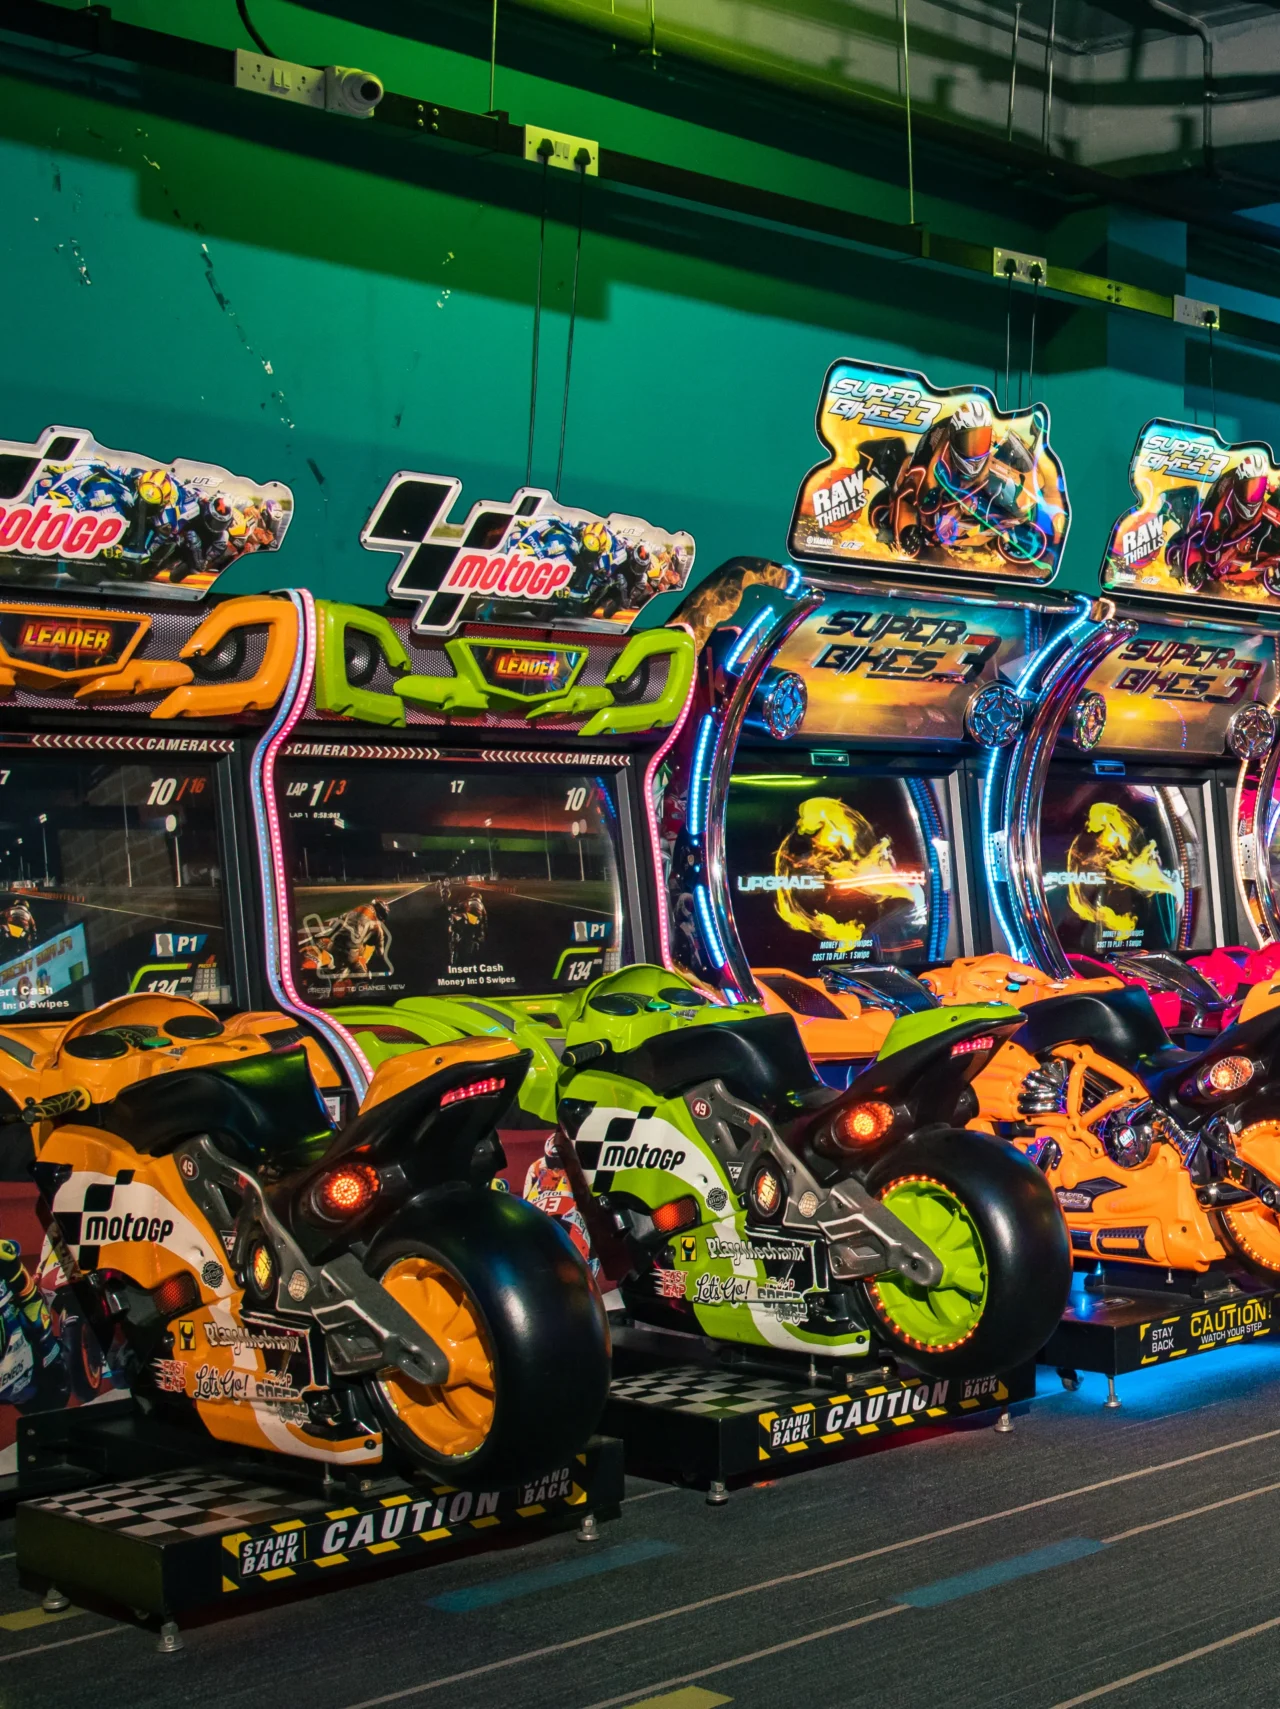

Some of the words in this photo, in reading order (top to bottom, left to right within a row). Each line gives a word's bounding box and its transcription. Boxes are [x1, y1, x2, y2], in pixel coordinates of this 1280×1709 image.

[830, 377, 922, 408] SUPER
[829, 398, 910, 425] BIKES
[1144, 435, 1215, 460] SUPER
[1140, 452, 1203, 473] BIKES
[812, 469, 865, 515] RAW
[816, 493, 868, 529] THRILLS
[0, 505, 123, 553] otoGP
[1122, 514, 1164, 554] RAW
[1124, 534, 1166, 566] THRILLS
[23, 624, 111, 650] LEADER
[816, 609, 967, 648] SUPER
[1118, 638, 1236, 672] SUPER
[497, 656, 560, 676] LEADER
[147, 739, 207, 751] CAMERA
[293, 744, 349, 757] CAMERA
[565, 753, 610, 765] CAMERA
[286, 782, 308, 796] LAP
[450, 781, 465, 794] 17
[738, 875, 825, 891] UPGRADE
[590, 924, 606, 937] P1
[177, 936, 198, 952] P1
[812, 953, 827, 961] COST
[448, 965, 478, 974] Insert
[479, 963, 504, 973] Cash
[568, 961, 592, 980] 134
[20, 985, 54, 996] Cash
[358, 984, 386, 993] CHANGE
[388, 983, 405, 991] VIEW
[438, 978, 465, 987] Money
[467, 977, 478, 985] In:
[479, 976, 485, 985] 0
[486, 976, 516, 985] Swipes
[2, 1001, 17, 1010] In:
[19, 1000, 26, 1009] 0
[29, 1000, 70, 1010] Swipes
[695, 1102, 707, 1116] 49
[181, 1159, 195, 1177] 49
[694, 1273, 722, 1302] Let's
[721, 1276, 750, 1305] Go!
[1190, 1301, 1272, 1338] CAUTION!
[1152, 1326, 1174, 1341] STAY
[1201, 1330, 1226, 1344] WATCH
[1227, 1324, 1246, 1341] YOUR
[1246, 1321, 1263, 1336] STEP
[1151, 1339, 1175, 1353] BACK
[194, 1365, 222, 1399] Let's
[221, 1369, 249, 1401] Go!
[964, 1379, 997, 1399] BACK
[772, 1414, 811, 1433] STAND
[826, 1379, 951, 1433] CAUTION
[772, 1425, 810, 1448] BACK
[523, 1480, 570, 1505] BACK
[242, 1531, 300, 1558] STAND
[322, 1490, 501, 1556] CAUTION
[242, 1546, 300, 1577] BACK
